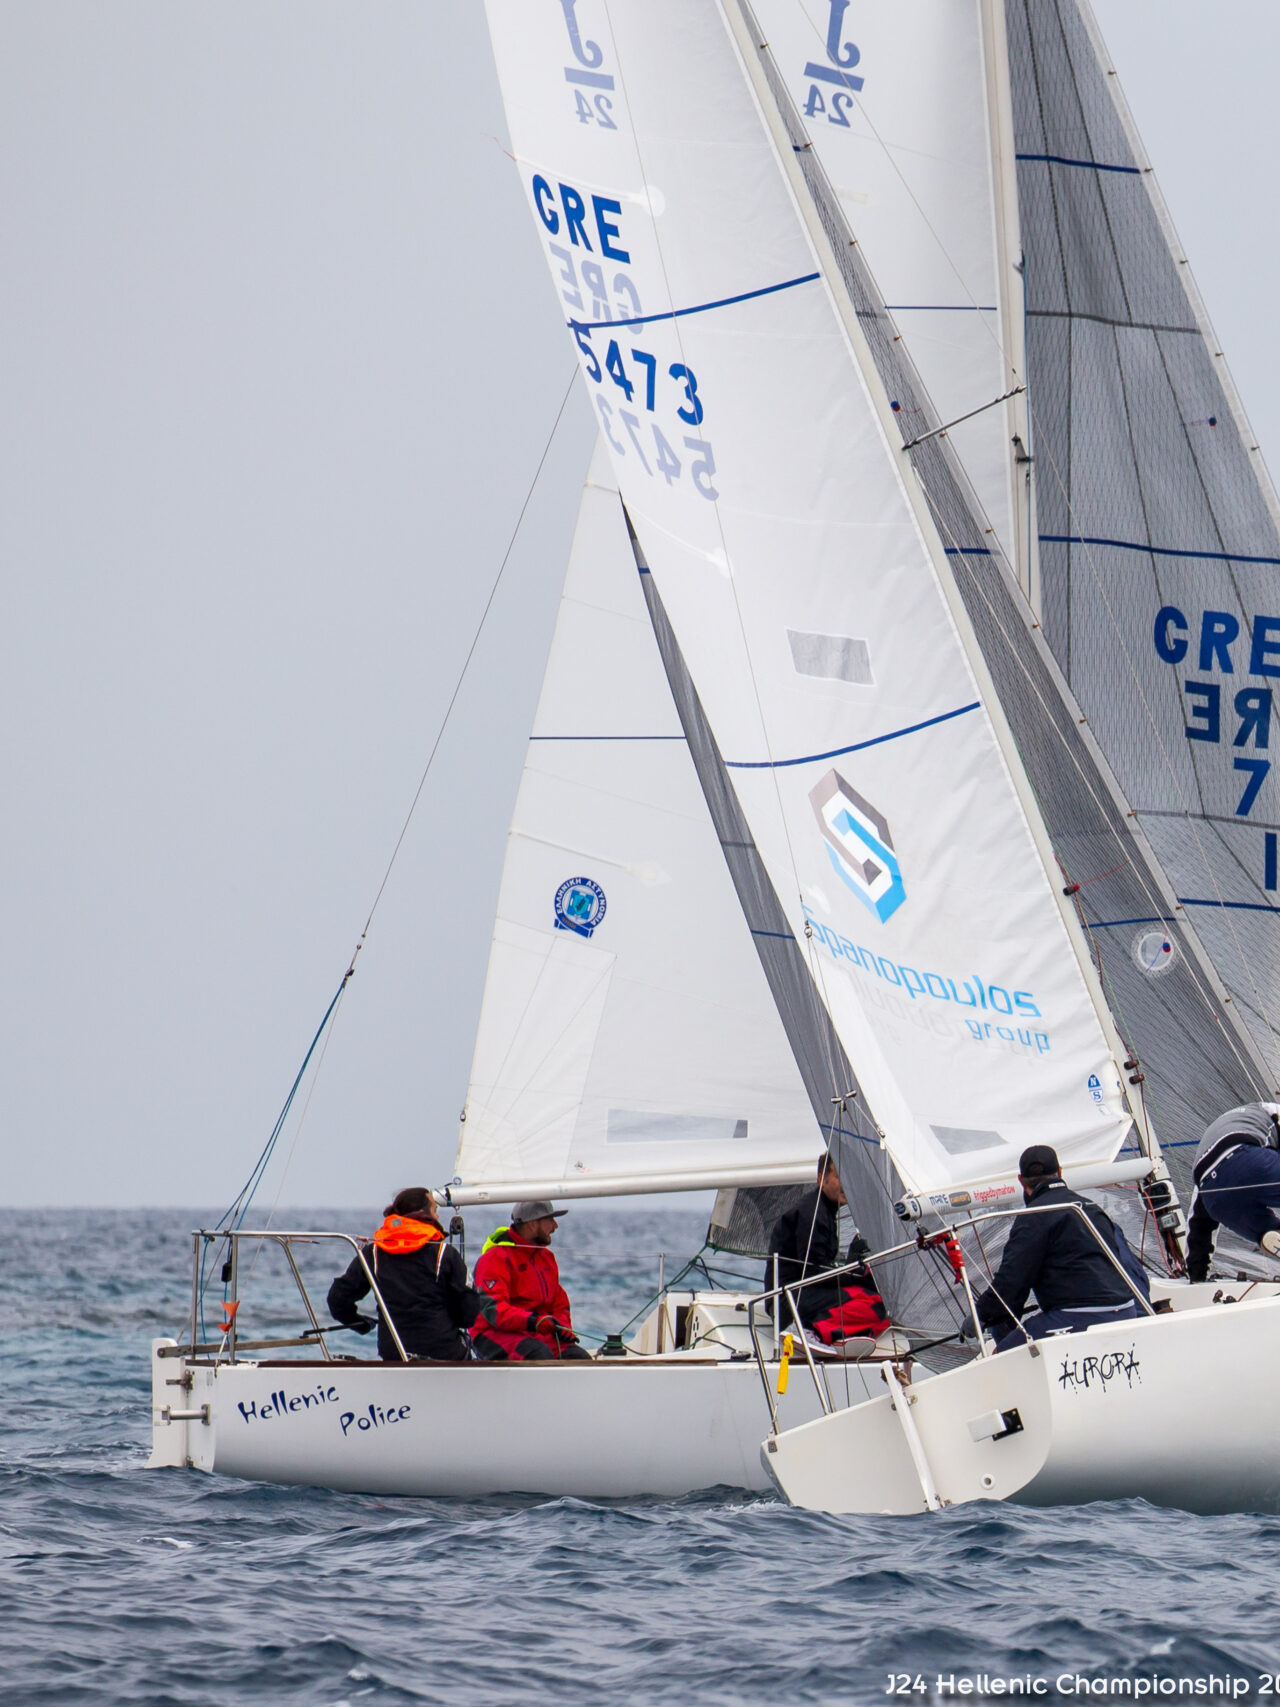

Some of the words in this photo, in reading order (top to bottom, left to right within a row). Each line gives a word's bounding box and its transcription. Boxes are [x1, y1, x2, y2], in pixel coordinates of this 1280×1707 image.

[532, 174, 631, 264] GRE
[570, 317, 704, 426] 5473
[801, 903, 1042, 1017] Spanopoulos
[965, 1019, 1050, 1054] group
[1058, 1343, 1142, 1395] AURORA
[237, 1385, 340, 1424] Hellenic
[339, 1402, 412, 1437] Police
